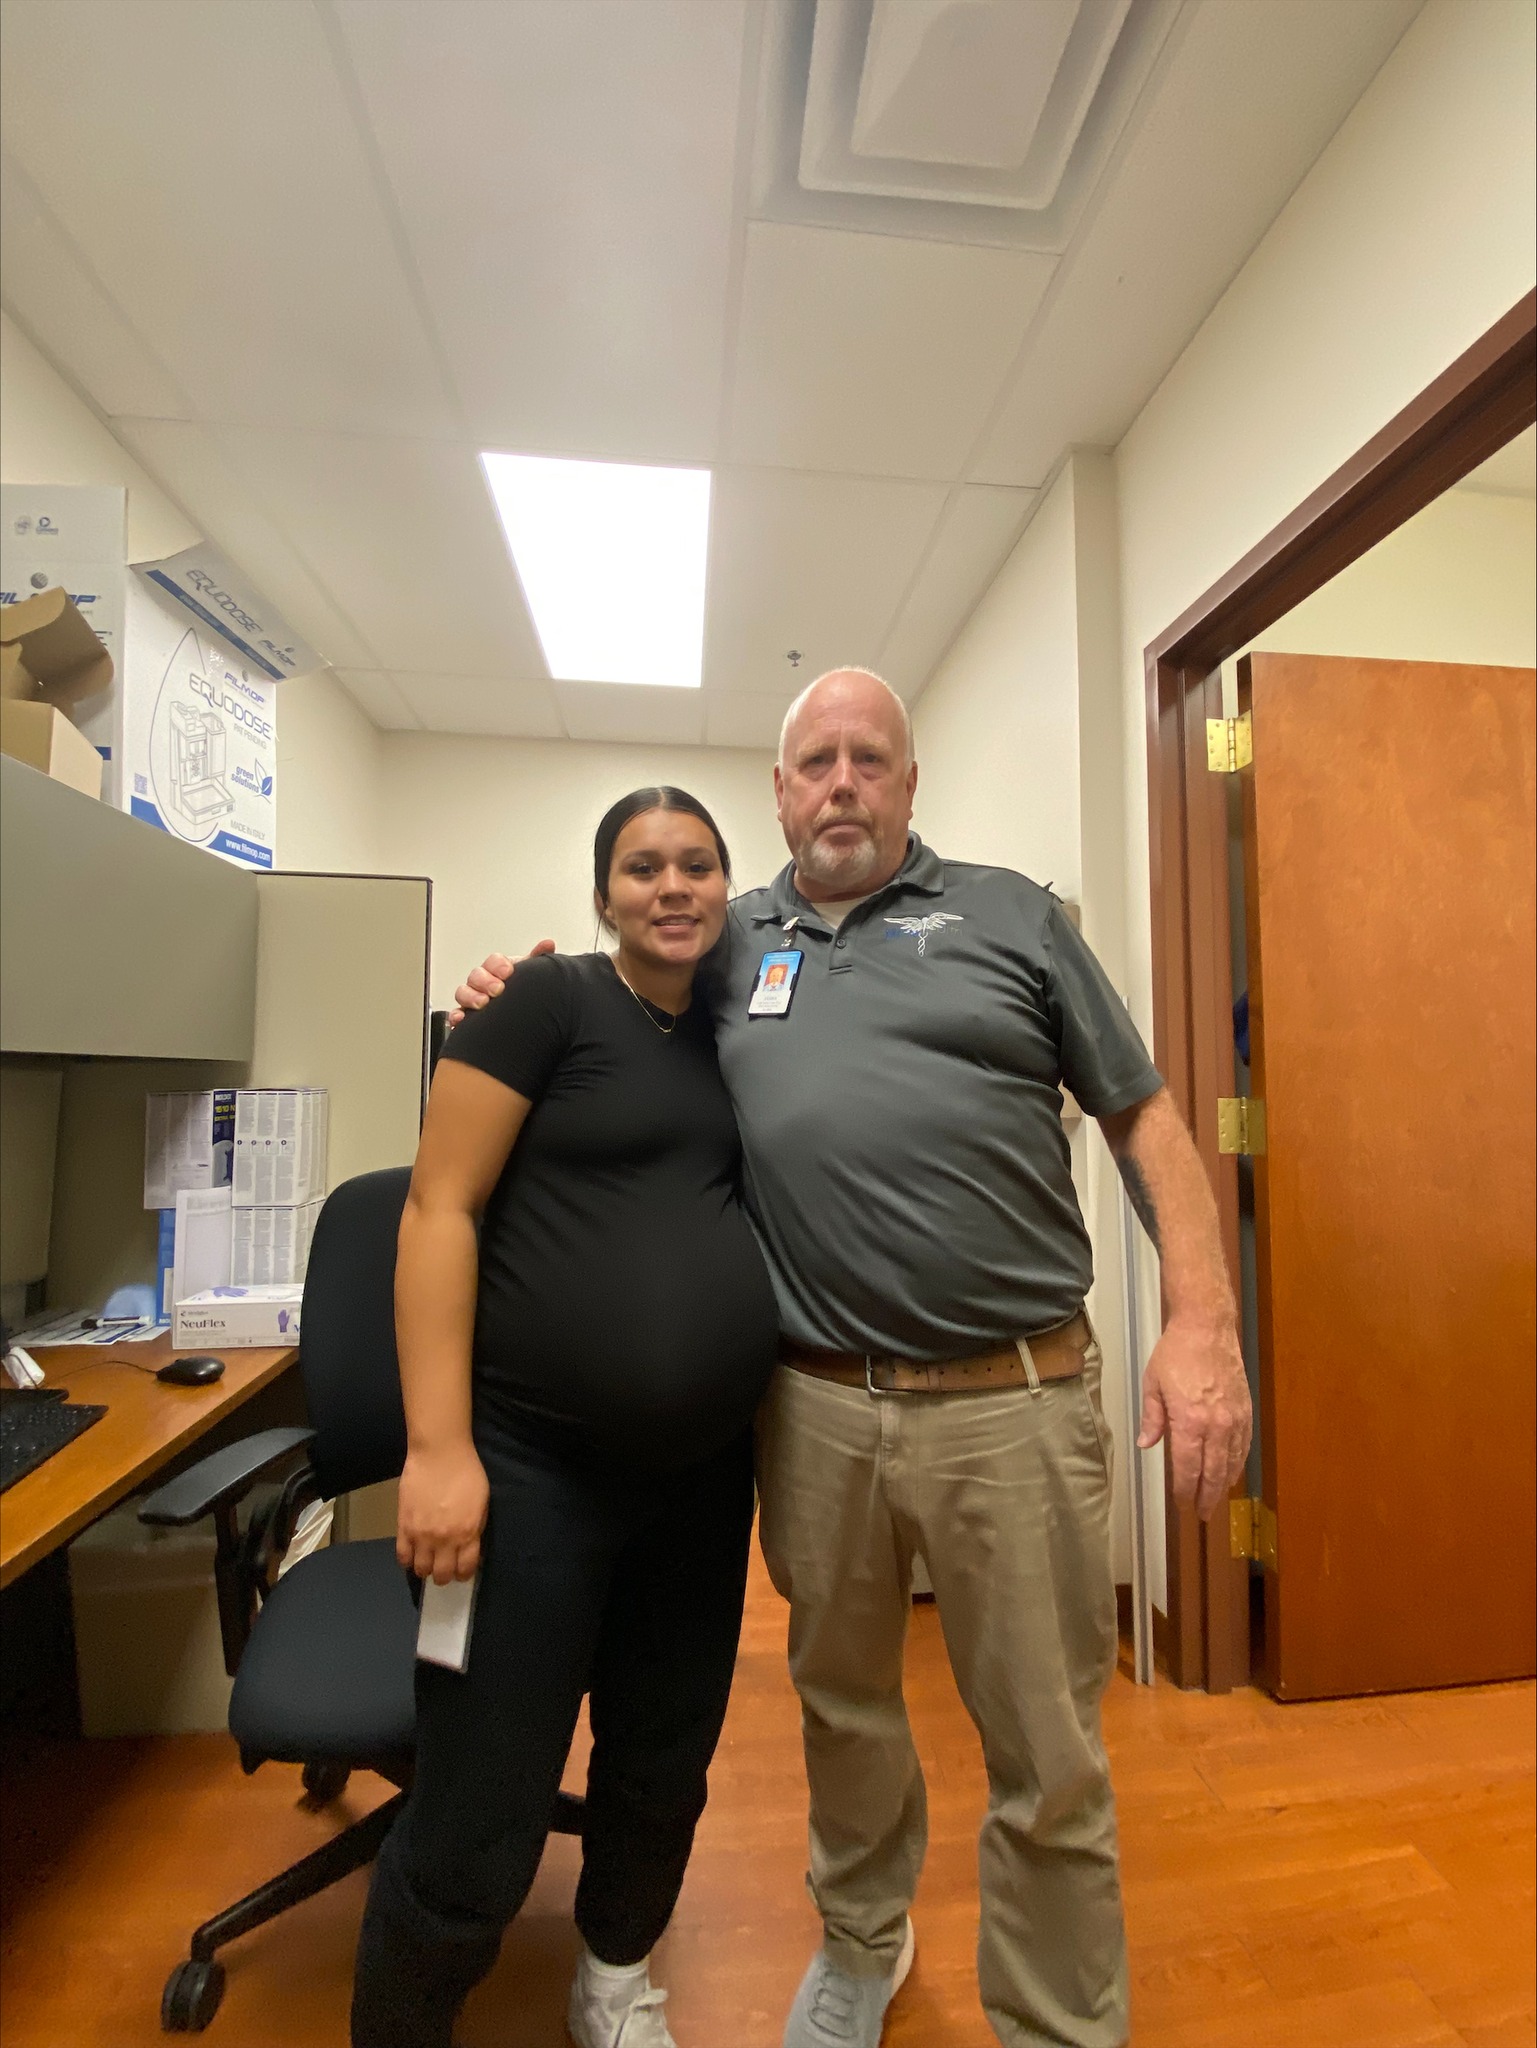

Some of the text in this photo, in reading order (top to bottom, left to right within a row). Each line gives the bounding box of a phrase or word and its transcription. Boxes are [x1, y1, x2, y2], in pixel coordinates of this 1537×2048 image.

[224, 672, 265, 703] FILMOP
[189, 673, 272, 740] EQUODOSE
[231, 773, 259, 793] solutions
[236, 766, 254, 781] green
[225, 839, 271, 862] www.filmop.com
[180, 1319, 226, 1330] NeuFlex
